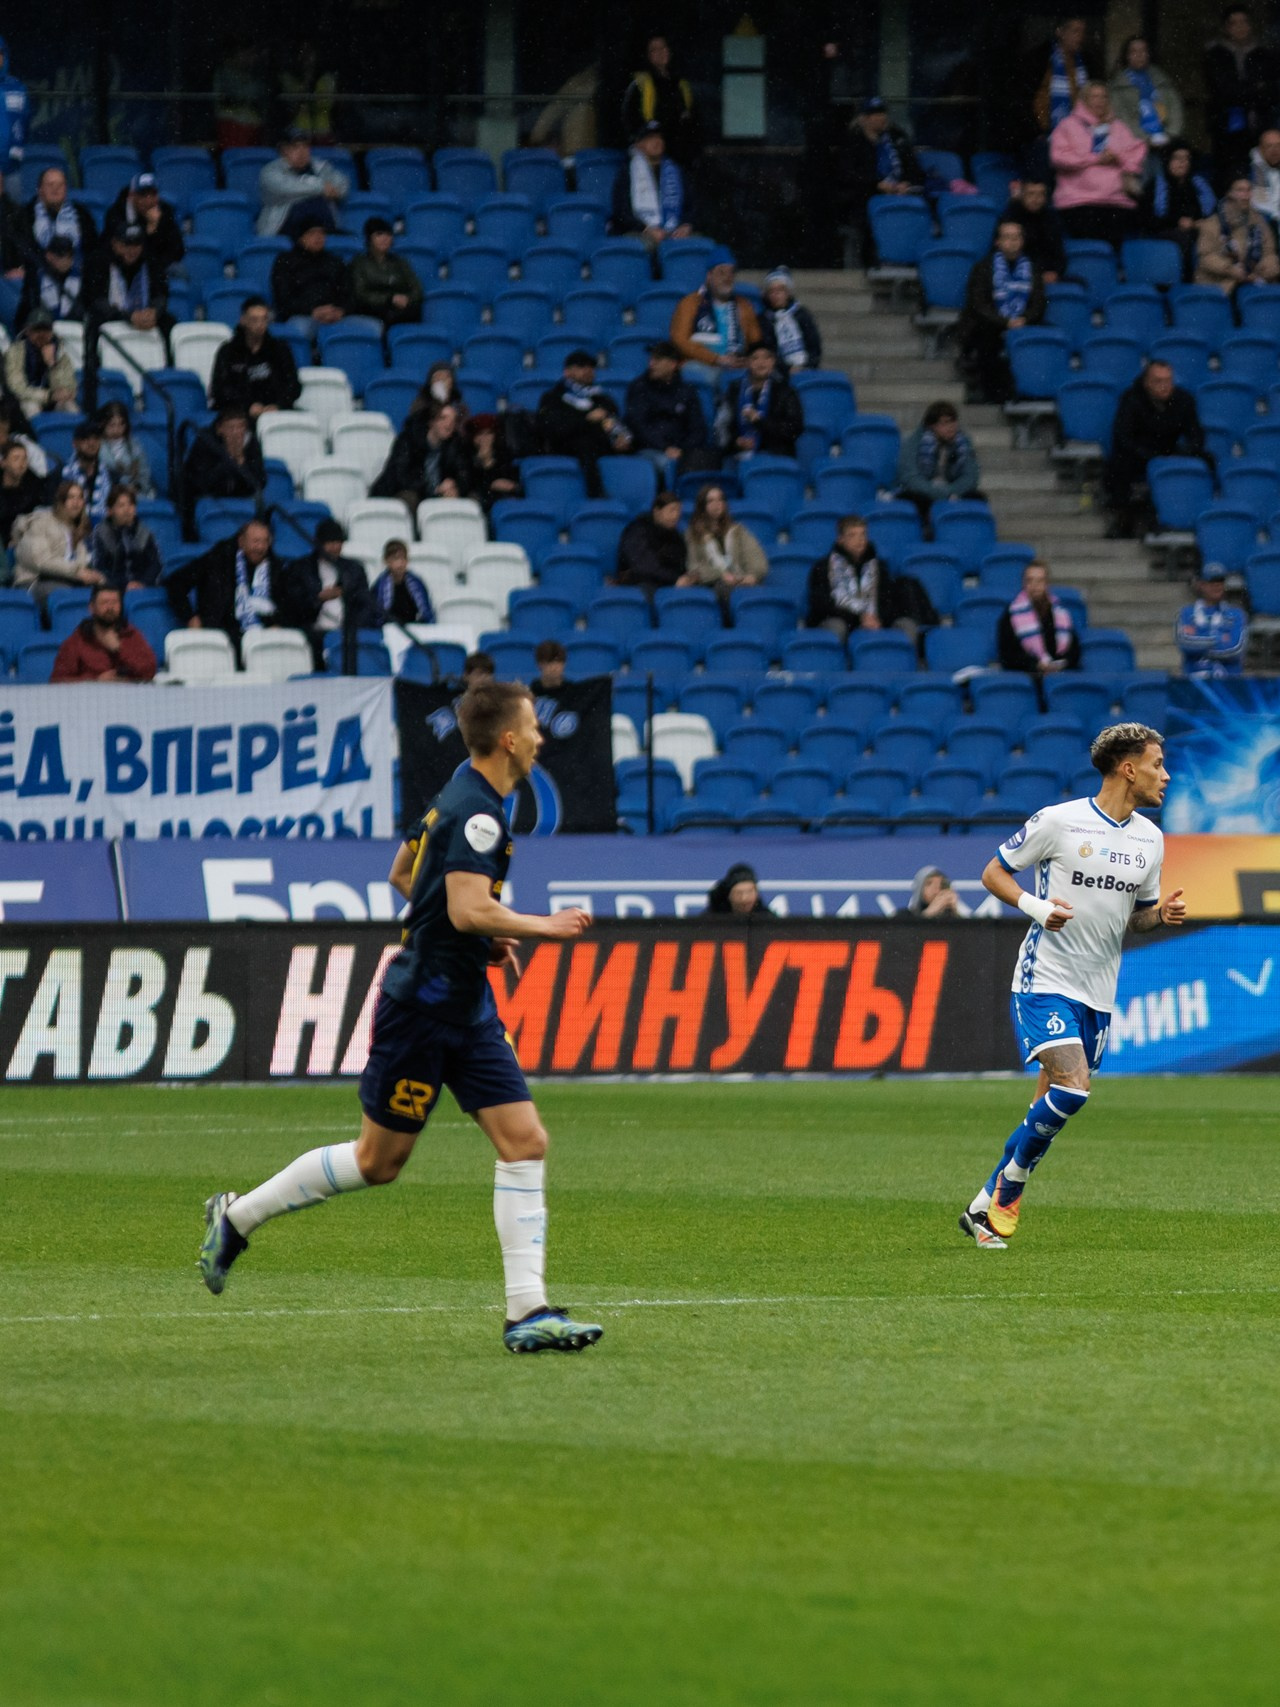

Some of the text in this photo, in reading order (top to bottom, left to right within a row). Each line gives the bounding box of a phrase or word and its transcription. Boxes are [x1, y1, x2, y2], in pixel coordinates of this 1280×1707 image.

[104, 704, 371, 795] ВПЕРЁД
[1109, 851, 1131, 866] ВТБ
[488, 941, 948, 1071] МИНУТЫ
[1109, 980, 1209, 1055] МИН
